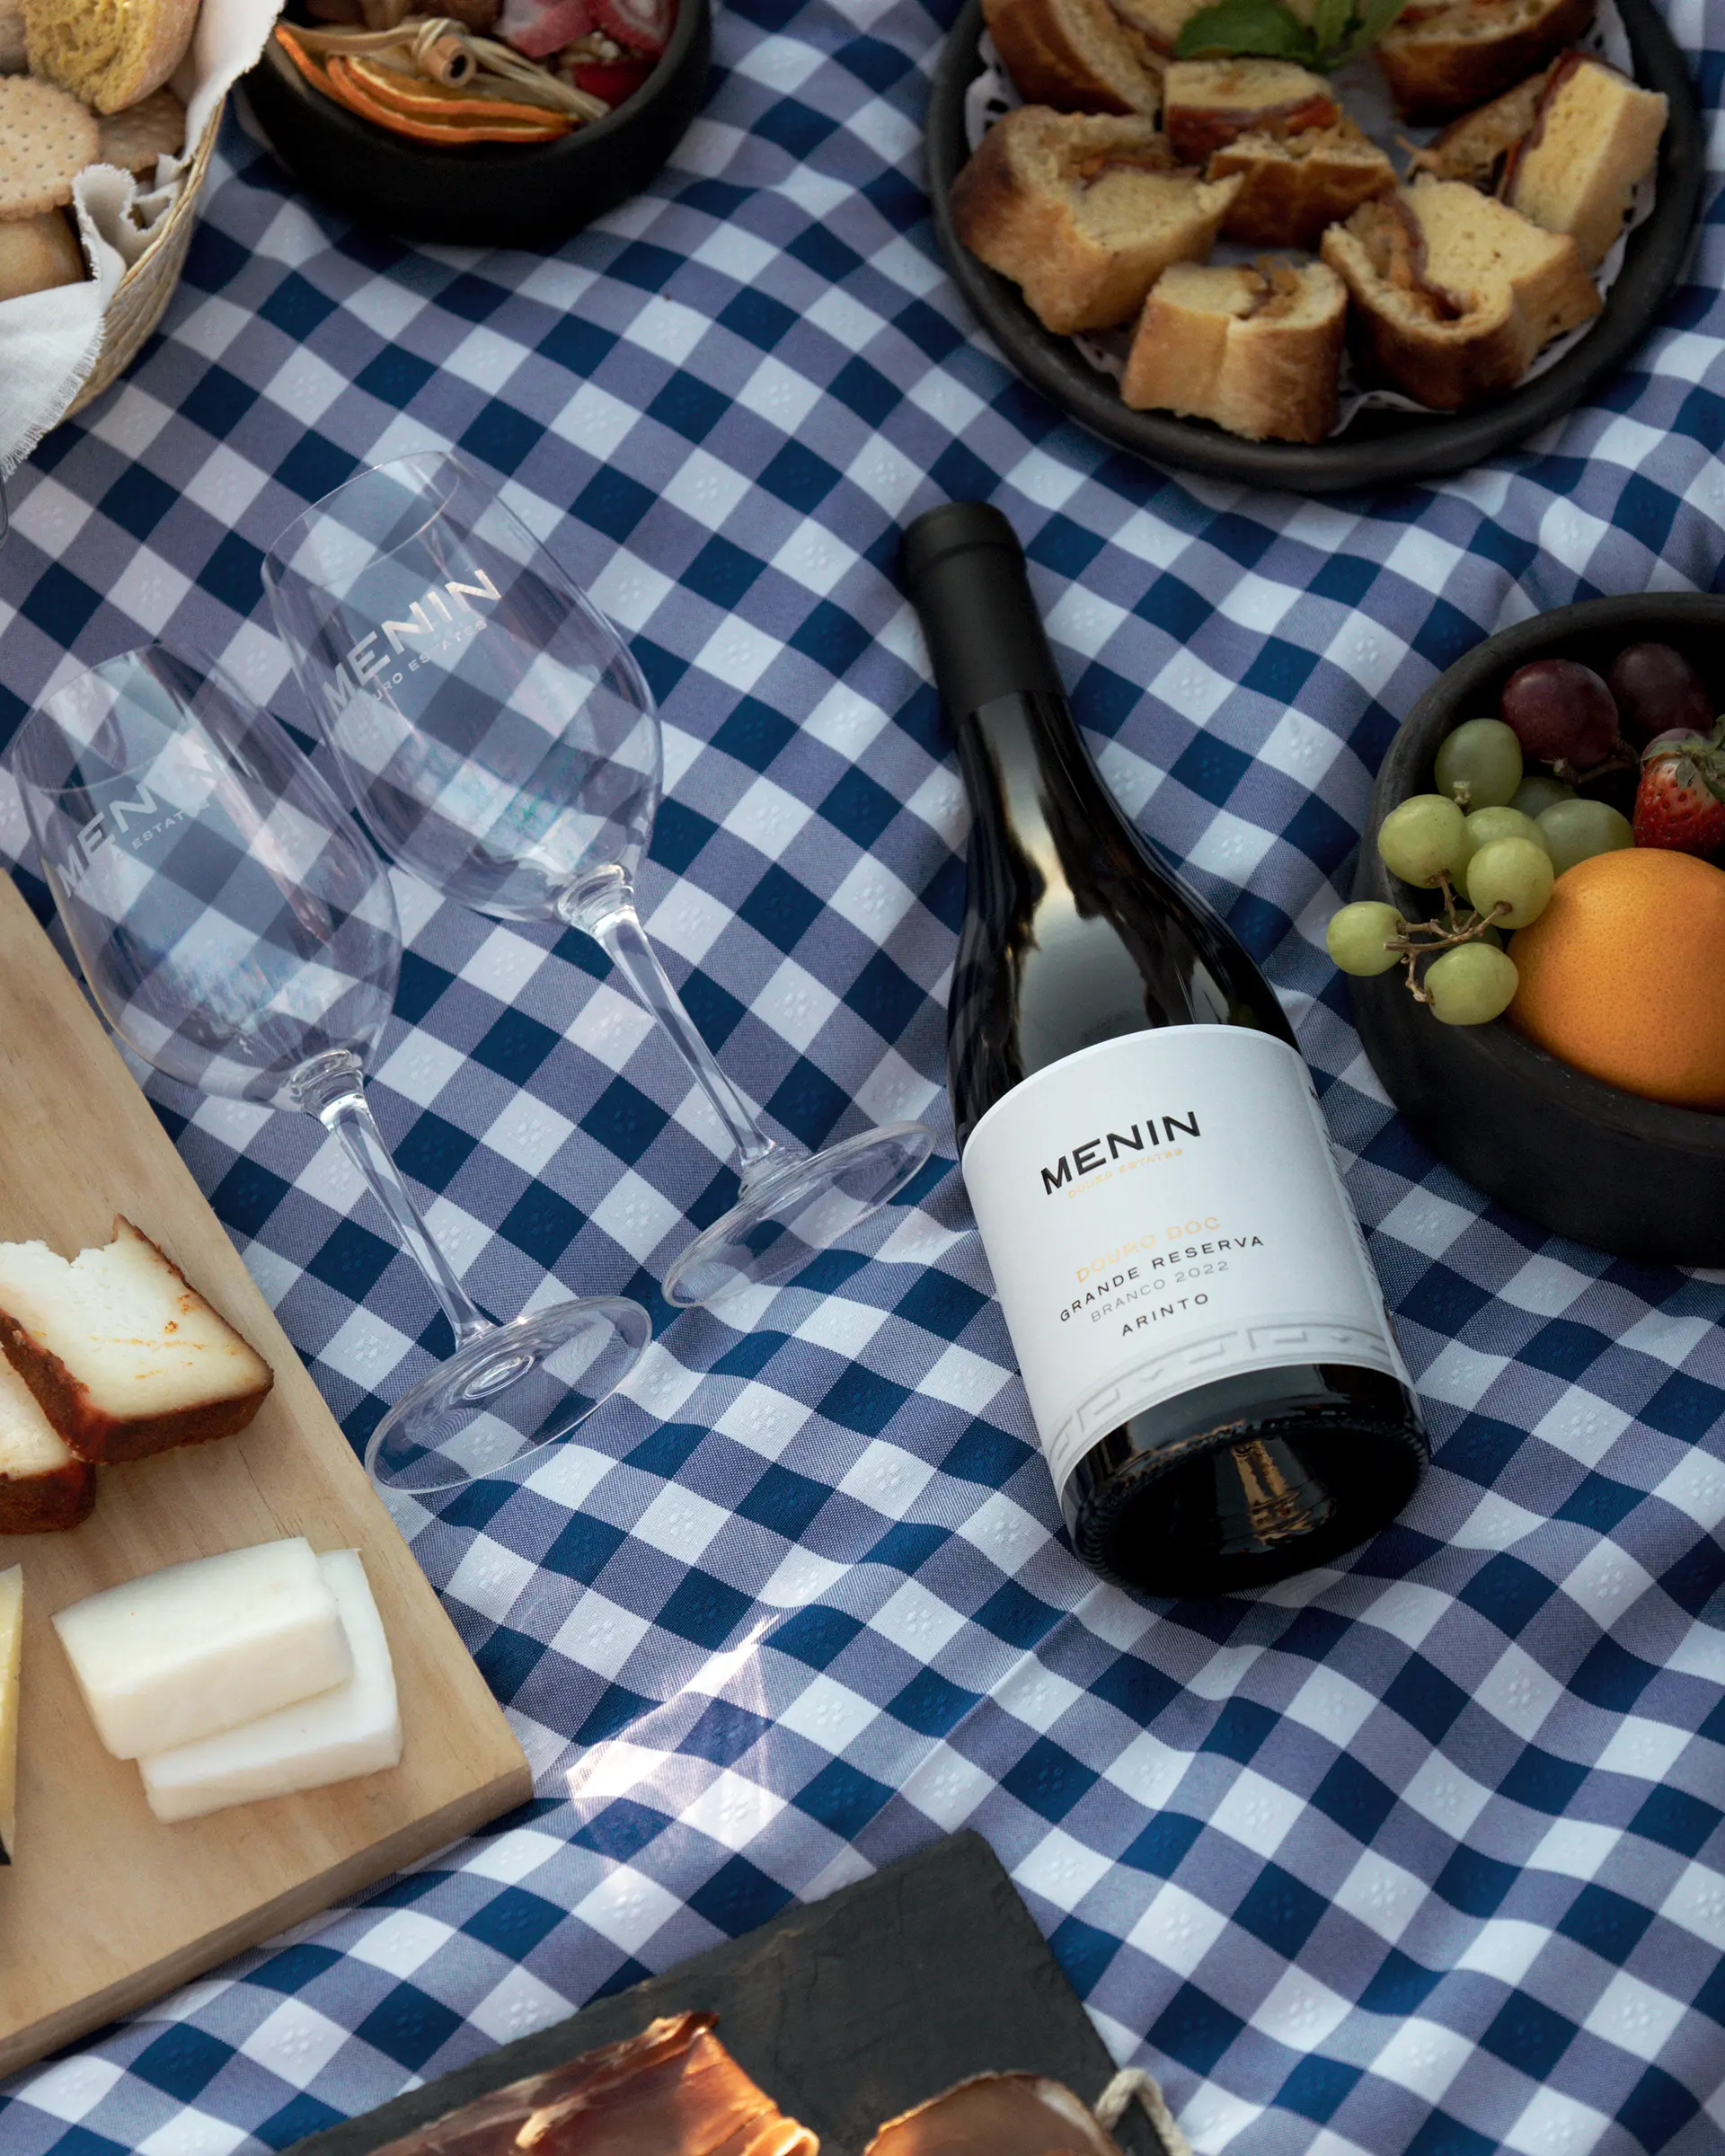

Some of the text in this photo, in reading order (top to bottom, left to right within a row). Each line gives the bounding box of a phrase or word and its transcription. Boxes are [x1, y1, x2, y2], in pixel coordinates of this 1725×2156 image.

[323, 569, 501, 714] MENIN
[57, 752, 226, 898] MENN
[131, 800, 210, 850] ESTATS
[1040, 1111, 1201, 1196] MENIN
[1060, 1235, 1265, 1322] GRANDE RESERVA
[1075, 1216, 1221, 1284] DOURO DOC
[1091, 1260, 1230, 1322] BRANCO 2022
[1122, 1293, 1208, 1337] ARINTO
